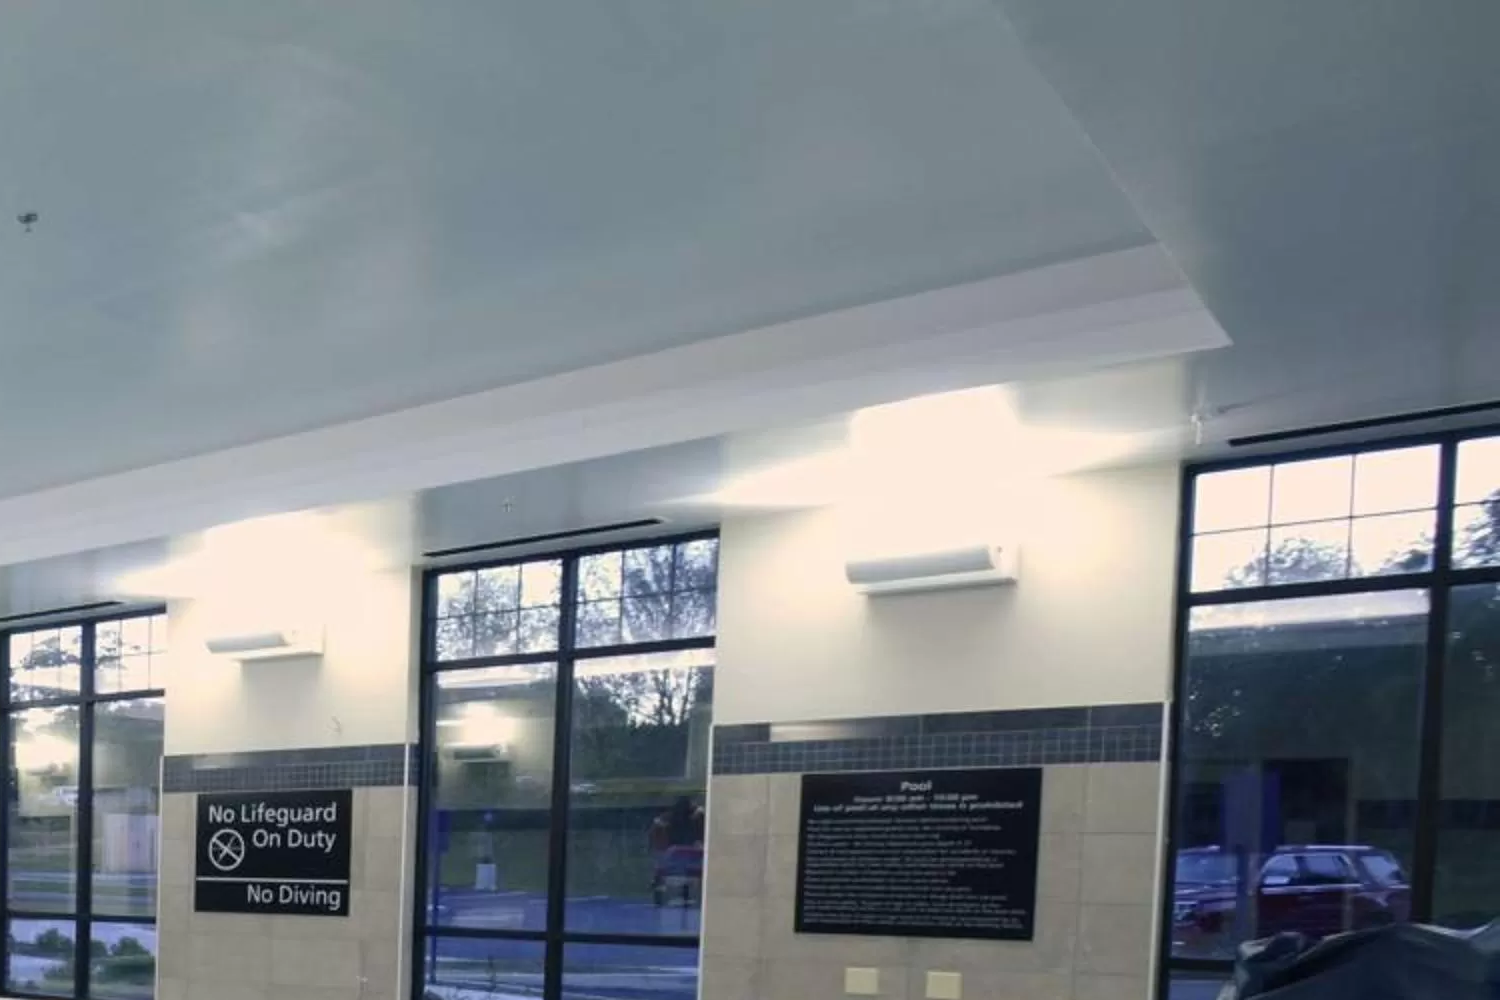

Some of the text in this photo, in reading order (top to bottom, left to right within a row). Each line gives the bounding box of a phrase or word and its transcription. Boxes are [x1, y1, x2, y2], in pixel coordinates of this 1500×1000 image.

[901, 780, 932, 793] Pool
[208, 801, 337, 827] No Lifeguard
[252, 828, 337, 853] On Duty
[247, 884, 341, 911] No Diving
